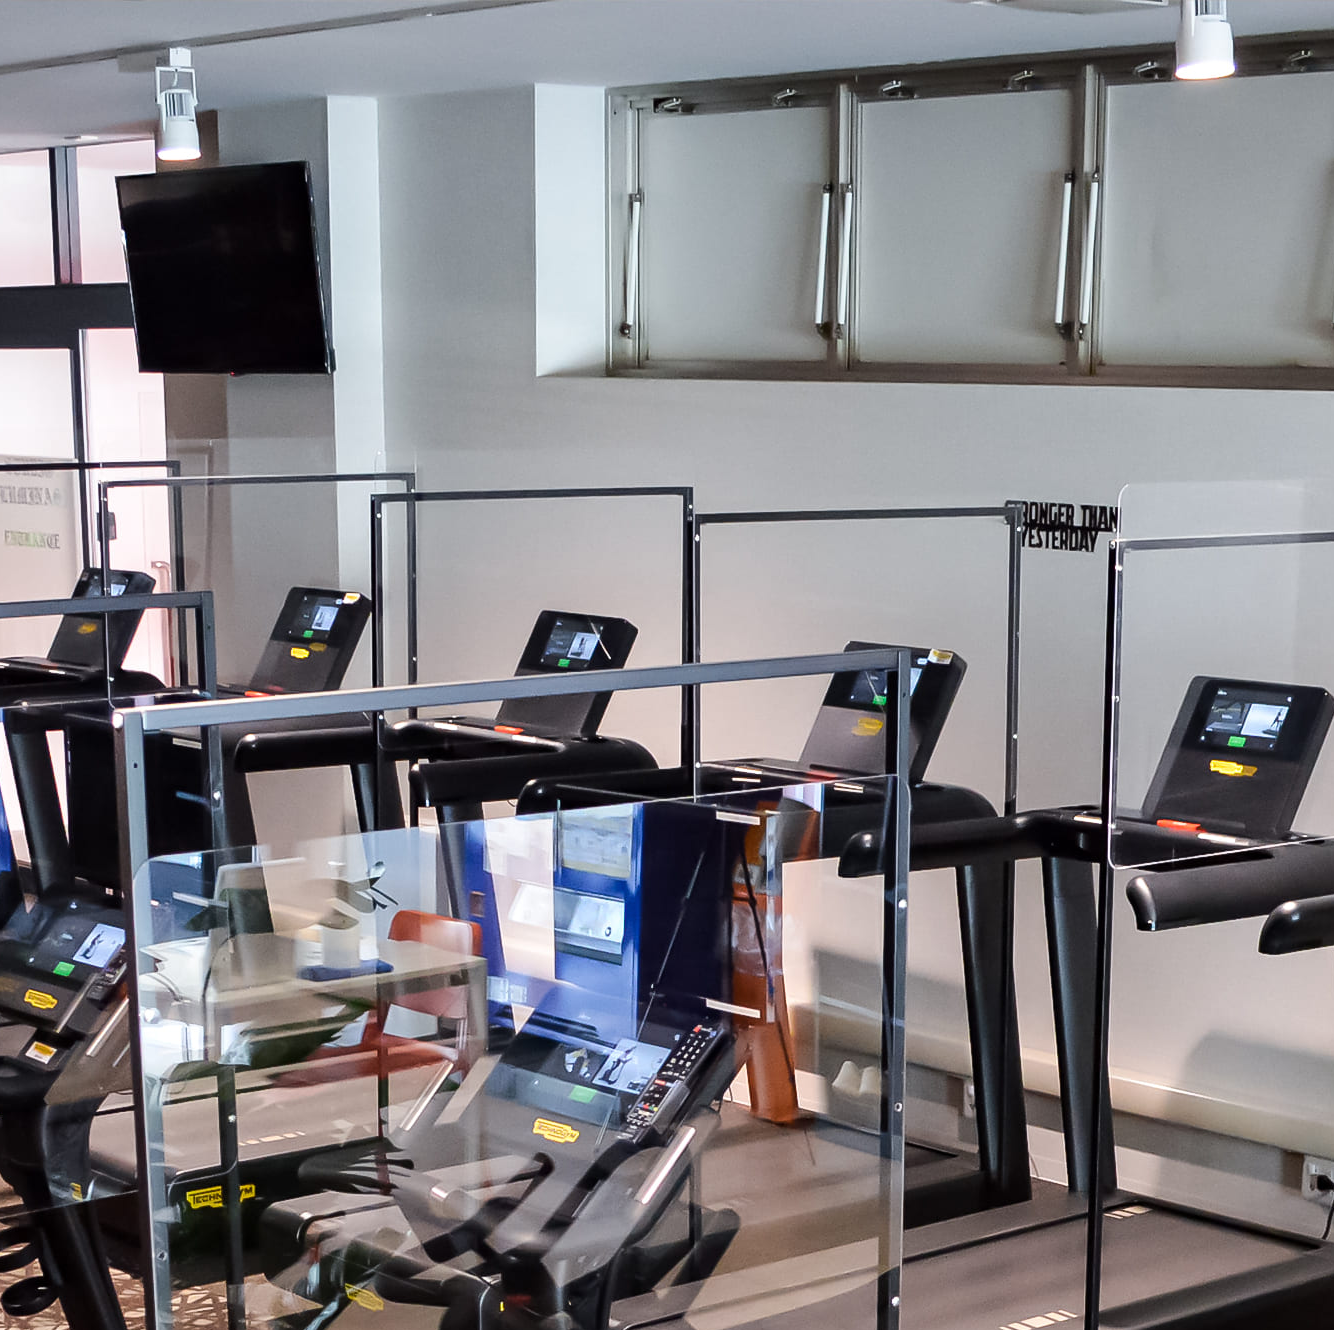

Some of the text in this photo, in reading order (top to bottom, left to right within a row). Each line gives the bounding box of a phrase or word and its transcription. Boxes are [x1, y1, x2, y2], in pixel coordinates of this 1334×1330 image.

[1020, 501, 1121, 531] RONGER THAN
[1022, 525, 1099, 552] YESTERDAY
